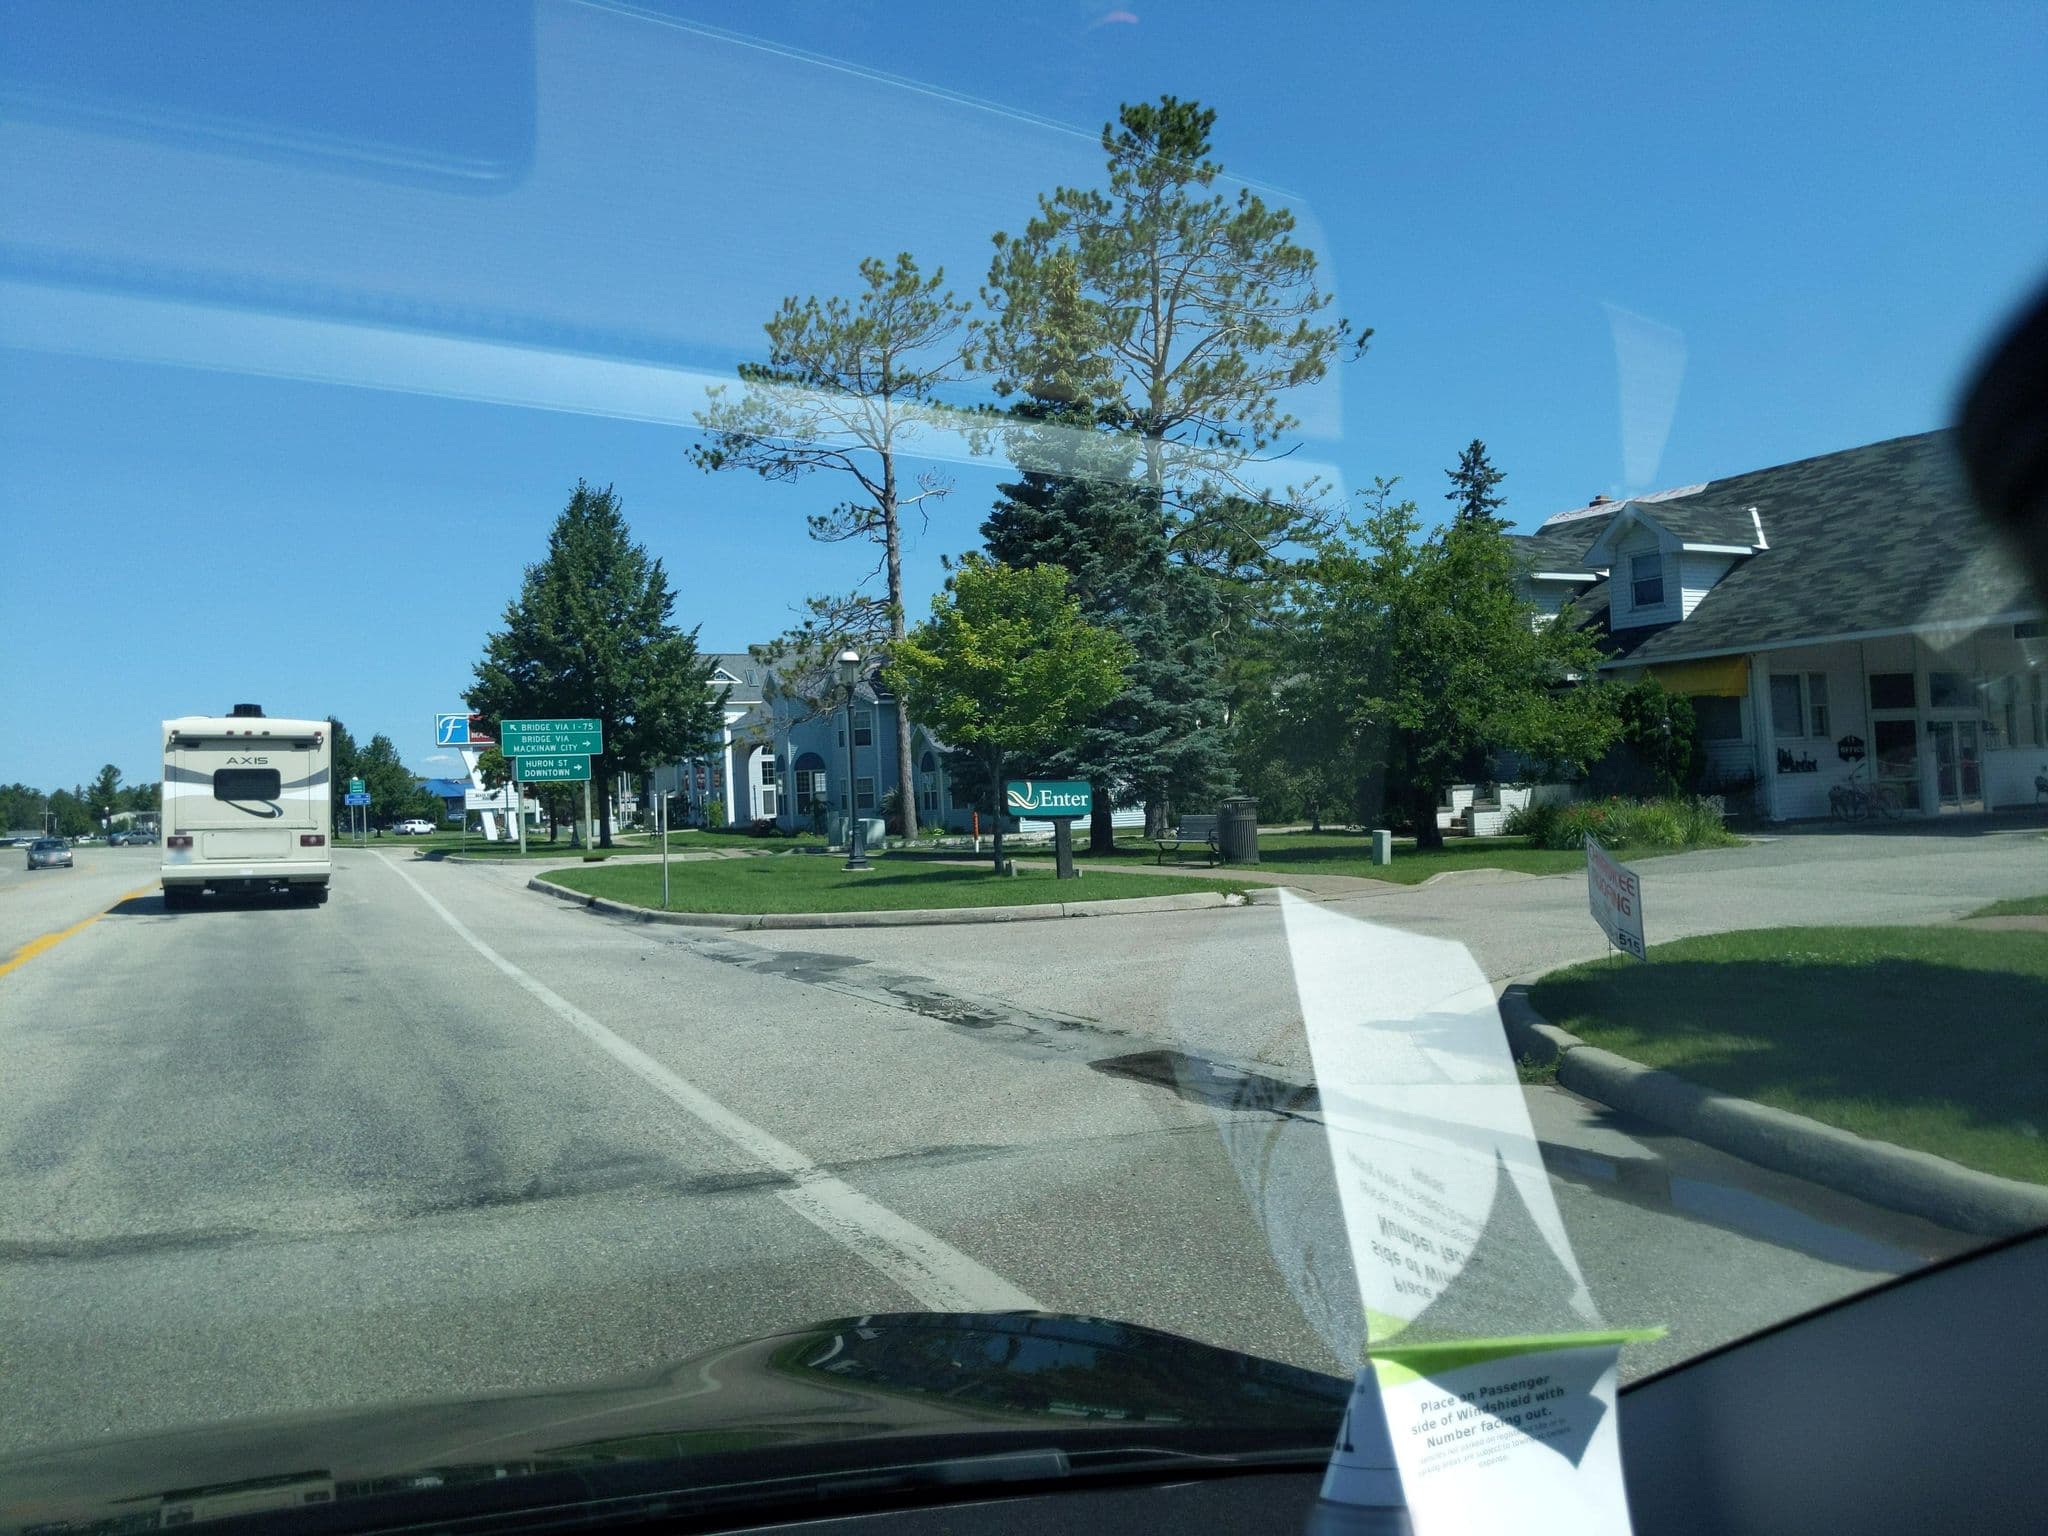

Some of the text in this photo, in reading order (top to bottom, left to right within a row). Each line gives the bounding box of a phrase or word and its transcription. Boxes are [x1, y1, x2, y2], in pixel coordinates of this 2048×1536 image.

[521, 723, 551, 732] BRIDGE
[555, 723, 569, 731] VIA
[521, 735, 551, 743] BRIDGE
[513, 743, 578, 753] MACKINAW CITY
[226, 757, 268, 765] AXIS
[525, 759, 568, 768] HURON ST
[524, 769, 570, 777] DOWNTOWN
[1040, 789, 1089, 807] Enter
[1618, 933, 1641, 953] 515
[1421, 1375, 1550, 1414] Place on Passenger
[1411, 1386, 1565, 1435] side of Windshield with
[1427, 1406, 1552, 1448] Number facing out.
